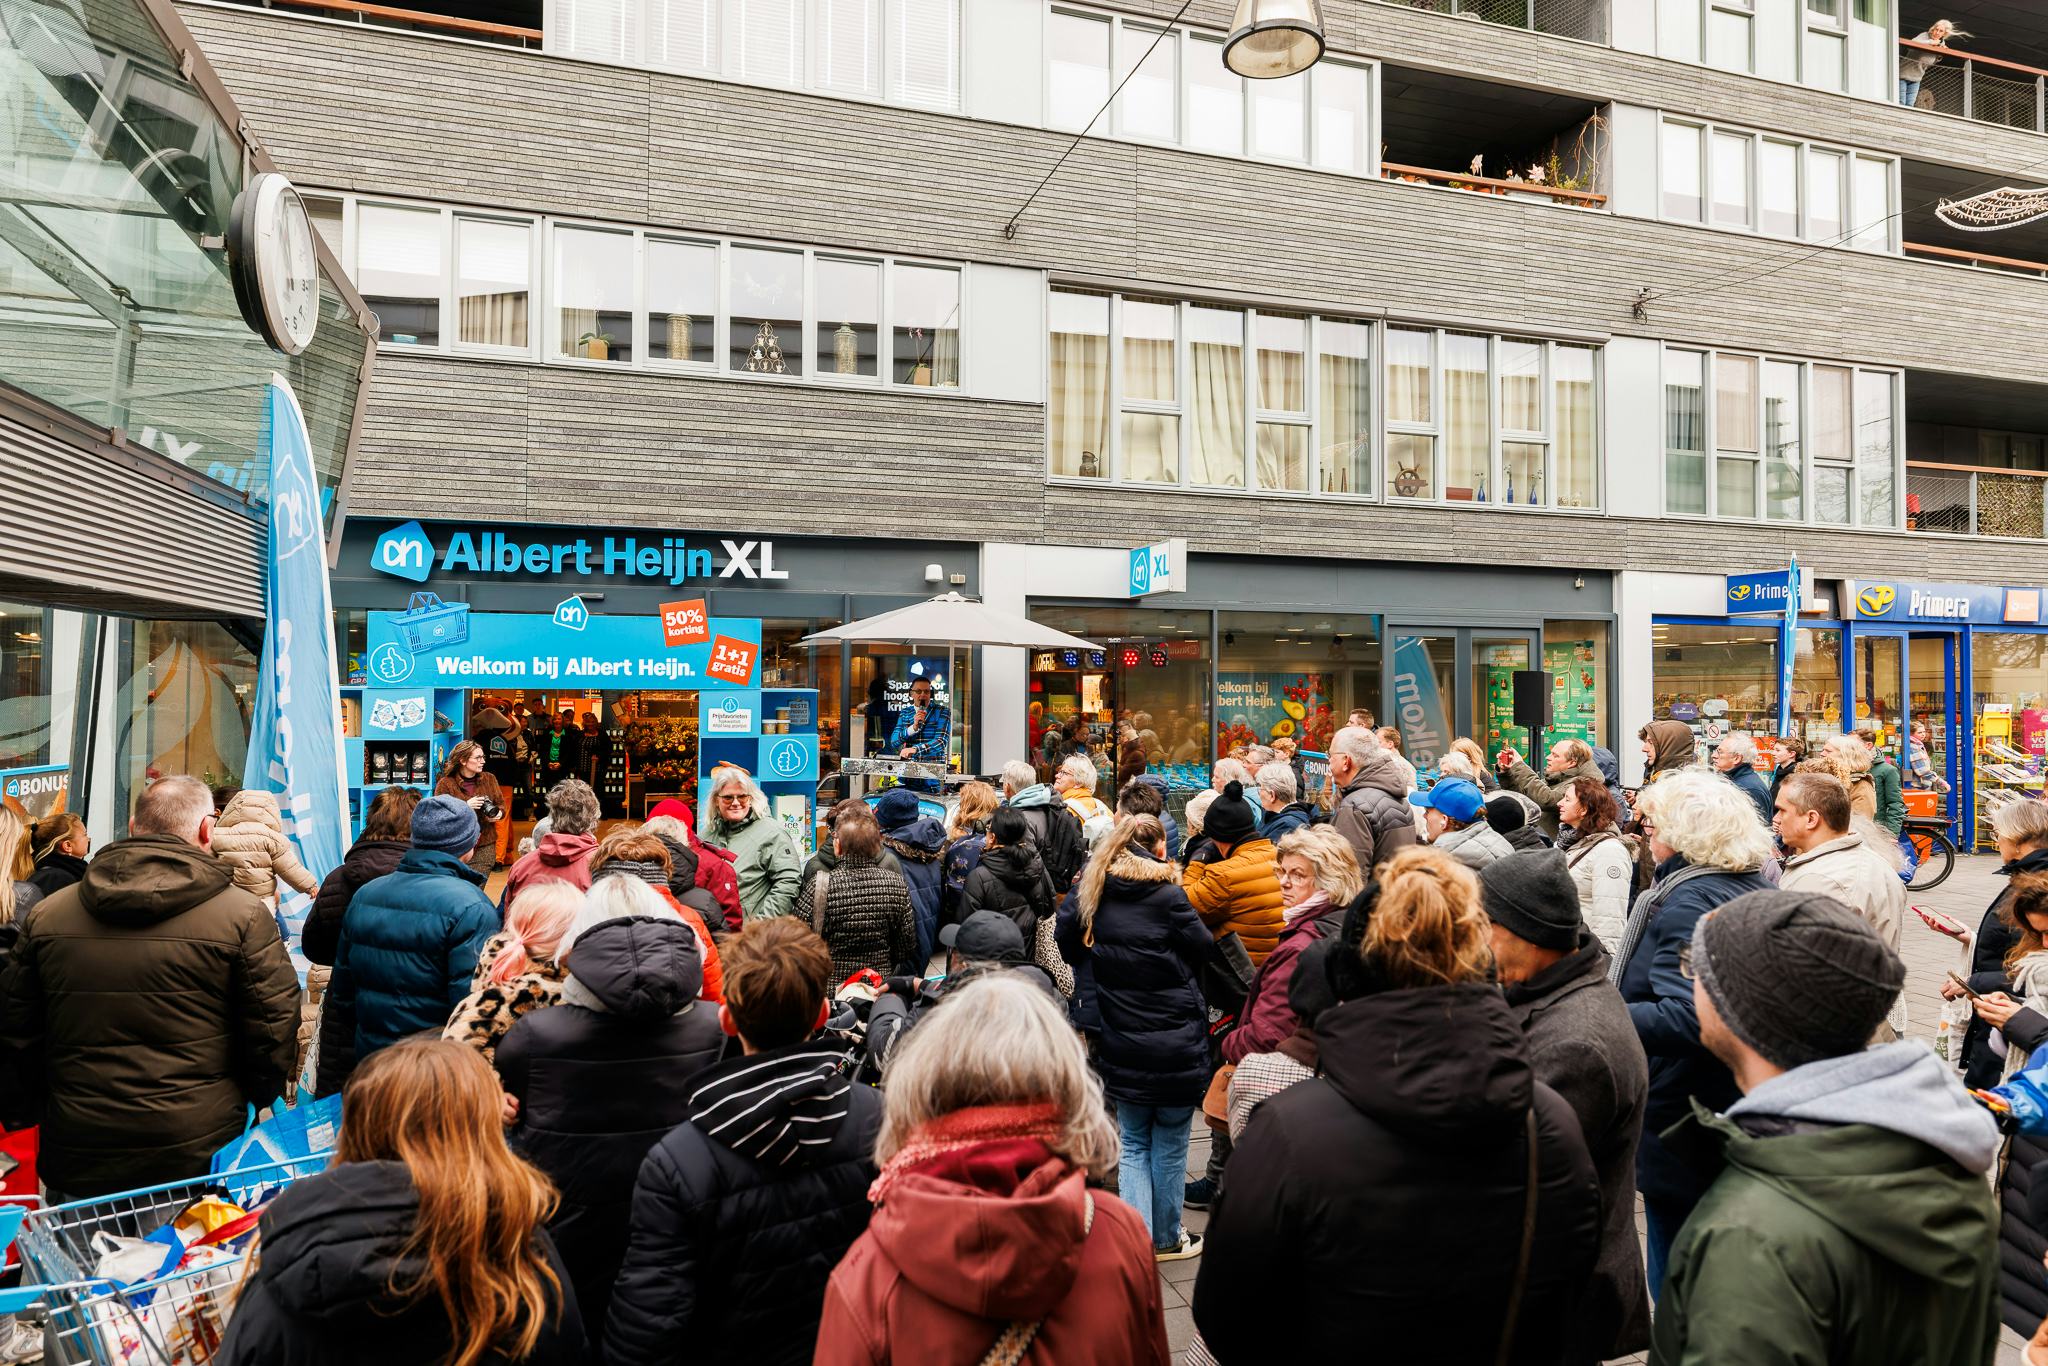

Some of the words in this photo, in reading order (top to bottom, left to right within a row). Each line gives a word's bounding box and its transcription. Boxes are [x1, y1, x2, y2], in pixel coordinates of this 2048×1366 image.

[441, 532, 592, 575] Albert
[604, 537, 713, 586] Heijn
[718, 539, 790, 580] XL
[1153, 553, 1169, 578] XL
[1754, 582, 1801, 600] Primea
[1908, 590, 1970, 618] Primera
[665, 608, 704, 627] 50%
[668, 624, 705, 637] korting
[715, 645, 749, 667] 1+1
[436, 656, 526, 676] Welkom
[532, 657, 559, 680] bij
[564, 658, 633, 677] Albert
[638, 658, 697, 681] Heijn.
[711, 660, 747, 677] gratis
[1256, 682, 1269, 695] bij
[1216, 696, 1242, 707] lbert
[1245, 696, 1277, 709] Heijn.
[1309, 761, 1333, 776] BONUS
[20, 774, 69, 796] BONUS
